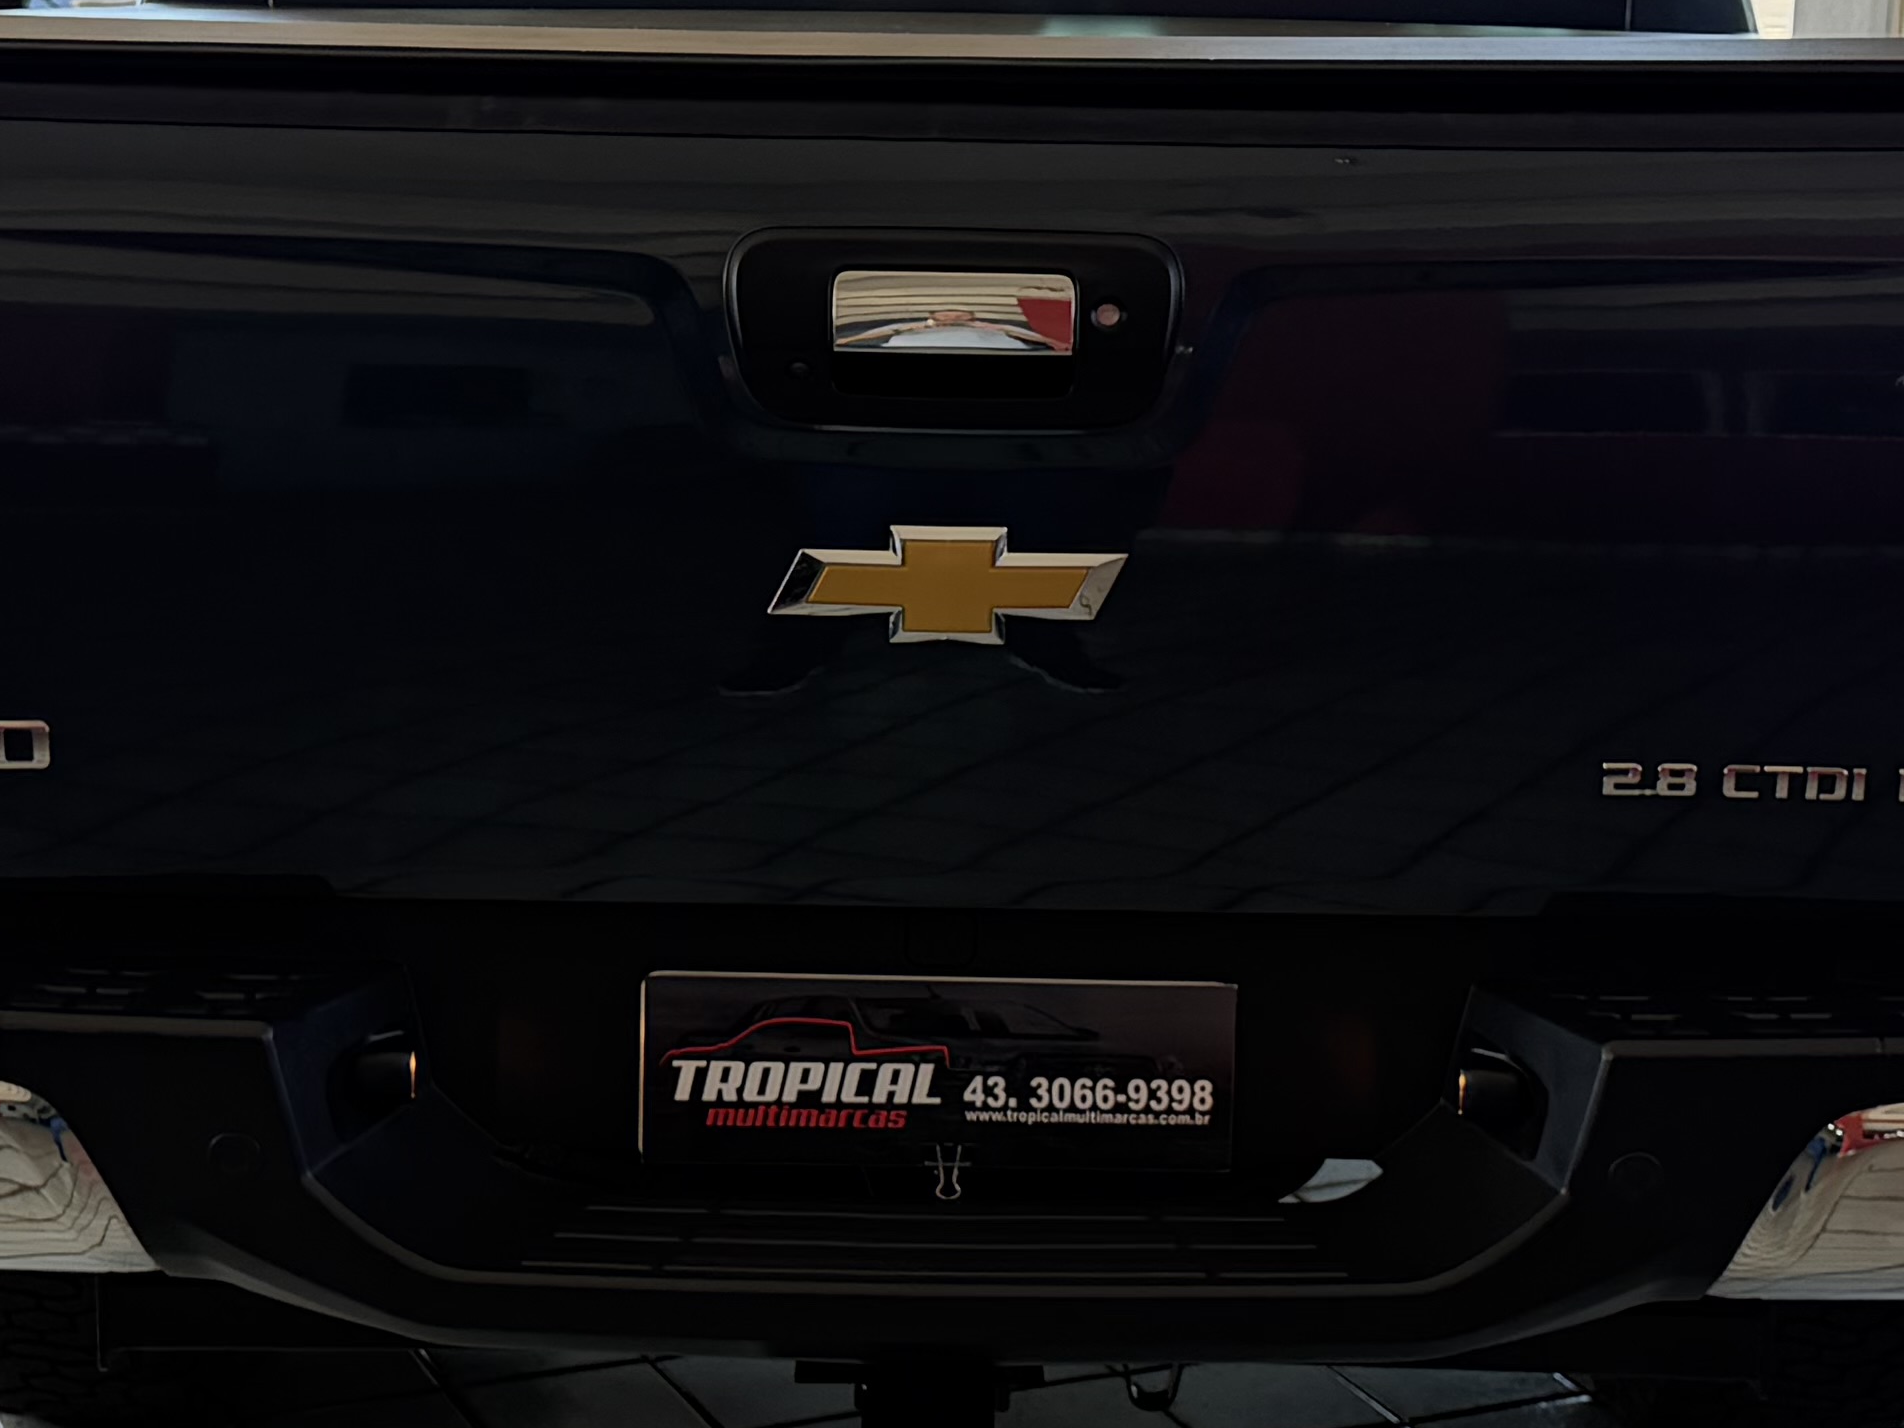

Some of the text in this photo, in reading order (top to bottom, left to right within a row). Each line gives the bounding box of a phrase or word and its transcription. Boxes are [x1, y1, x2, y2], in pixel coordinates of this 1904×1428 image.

[671, 1058, 942, 1105] TROPICAL
[962, 1075, 1214, 1113] 43. 3066-9398
[705, 1105, 907, 1130] multimarcas
[963, 1108, 1212, 1127] www.tropicalmultimarcas.com.br
